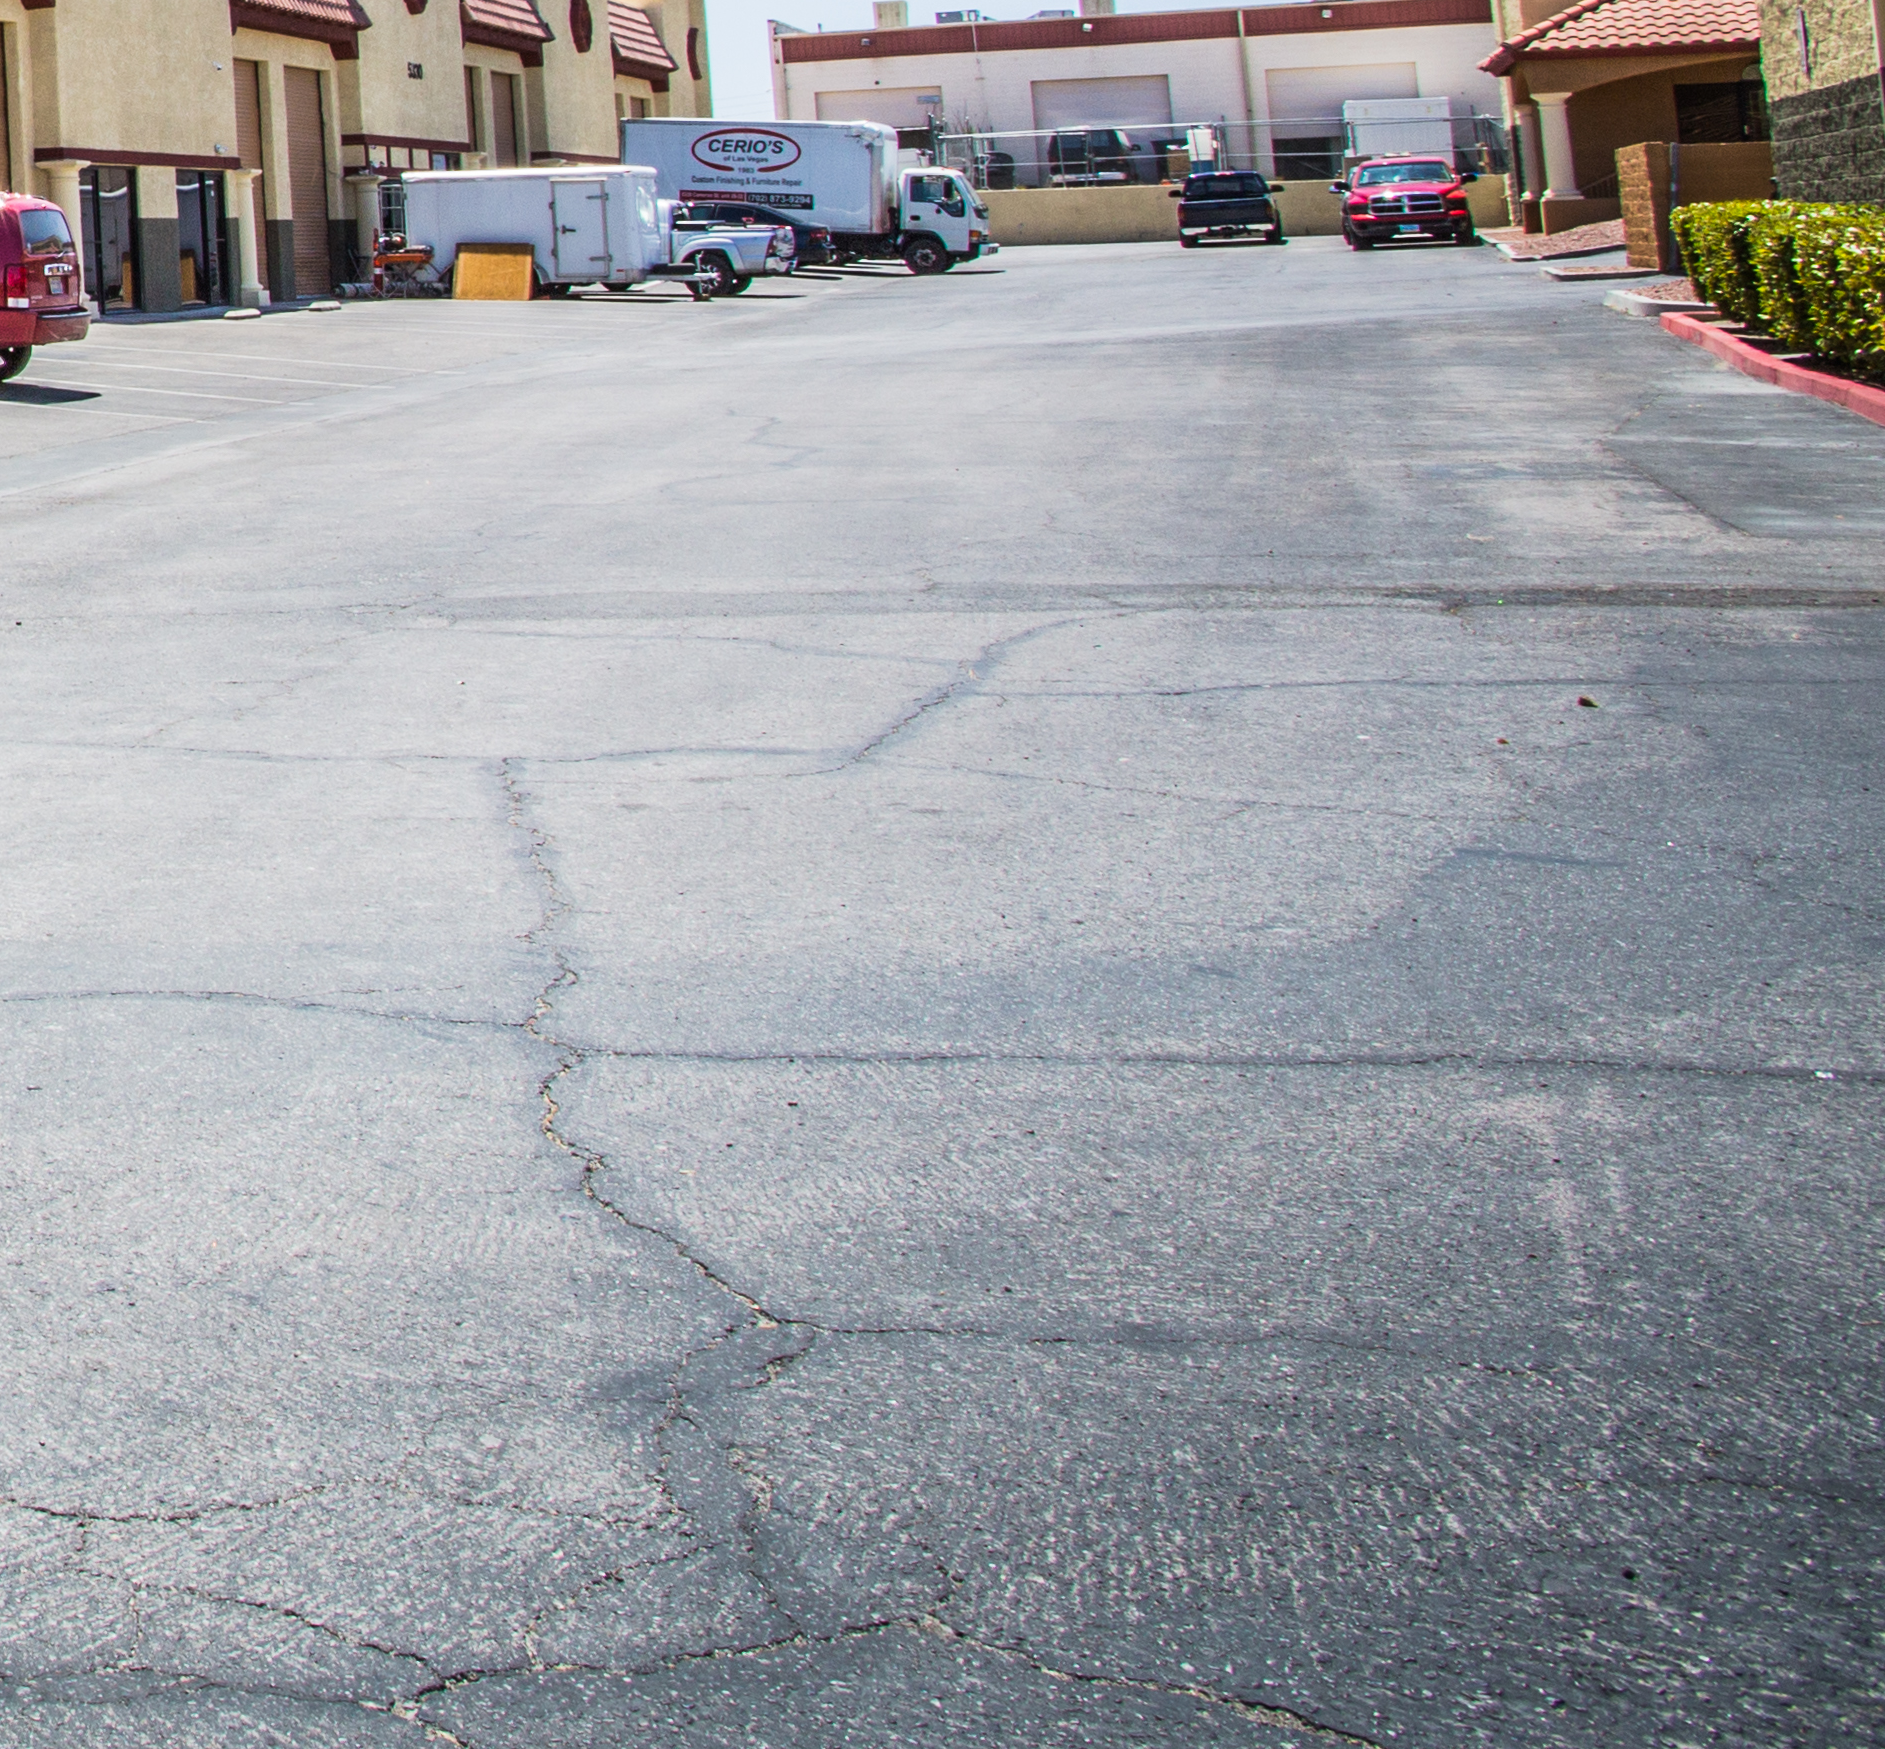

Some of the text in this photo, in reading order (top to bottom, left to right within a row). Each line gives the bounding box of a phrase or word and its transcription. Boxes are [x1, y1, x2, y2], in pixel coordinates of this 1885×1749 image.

[708, 139, 784, 154] CERIO'S
[746, 155, 769, 164] Vegas
[716, 176, 745, 186] Finishing
[752, 177, 780, 186] Furniture
[781, 178, 802, 187] Repair
